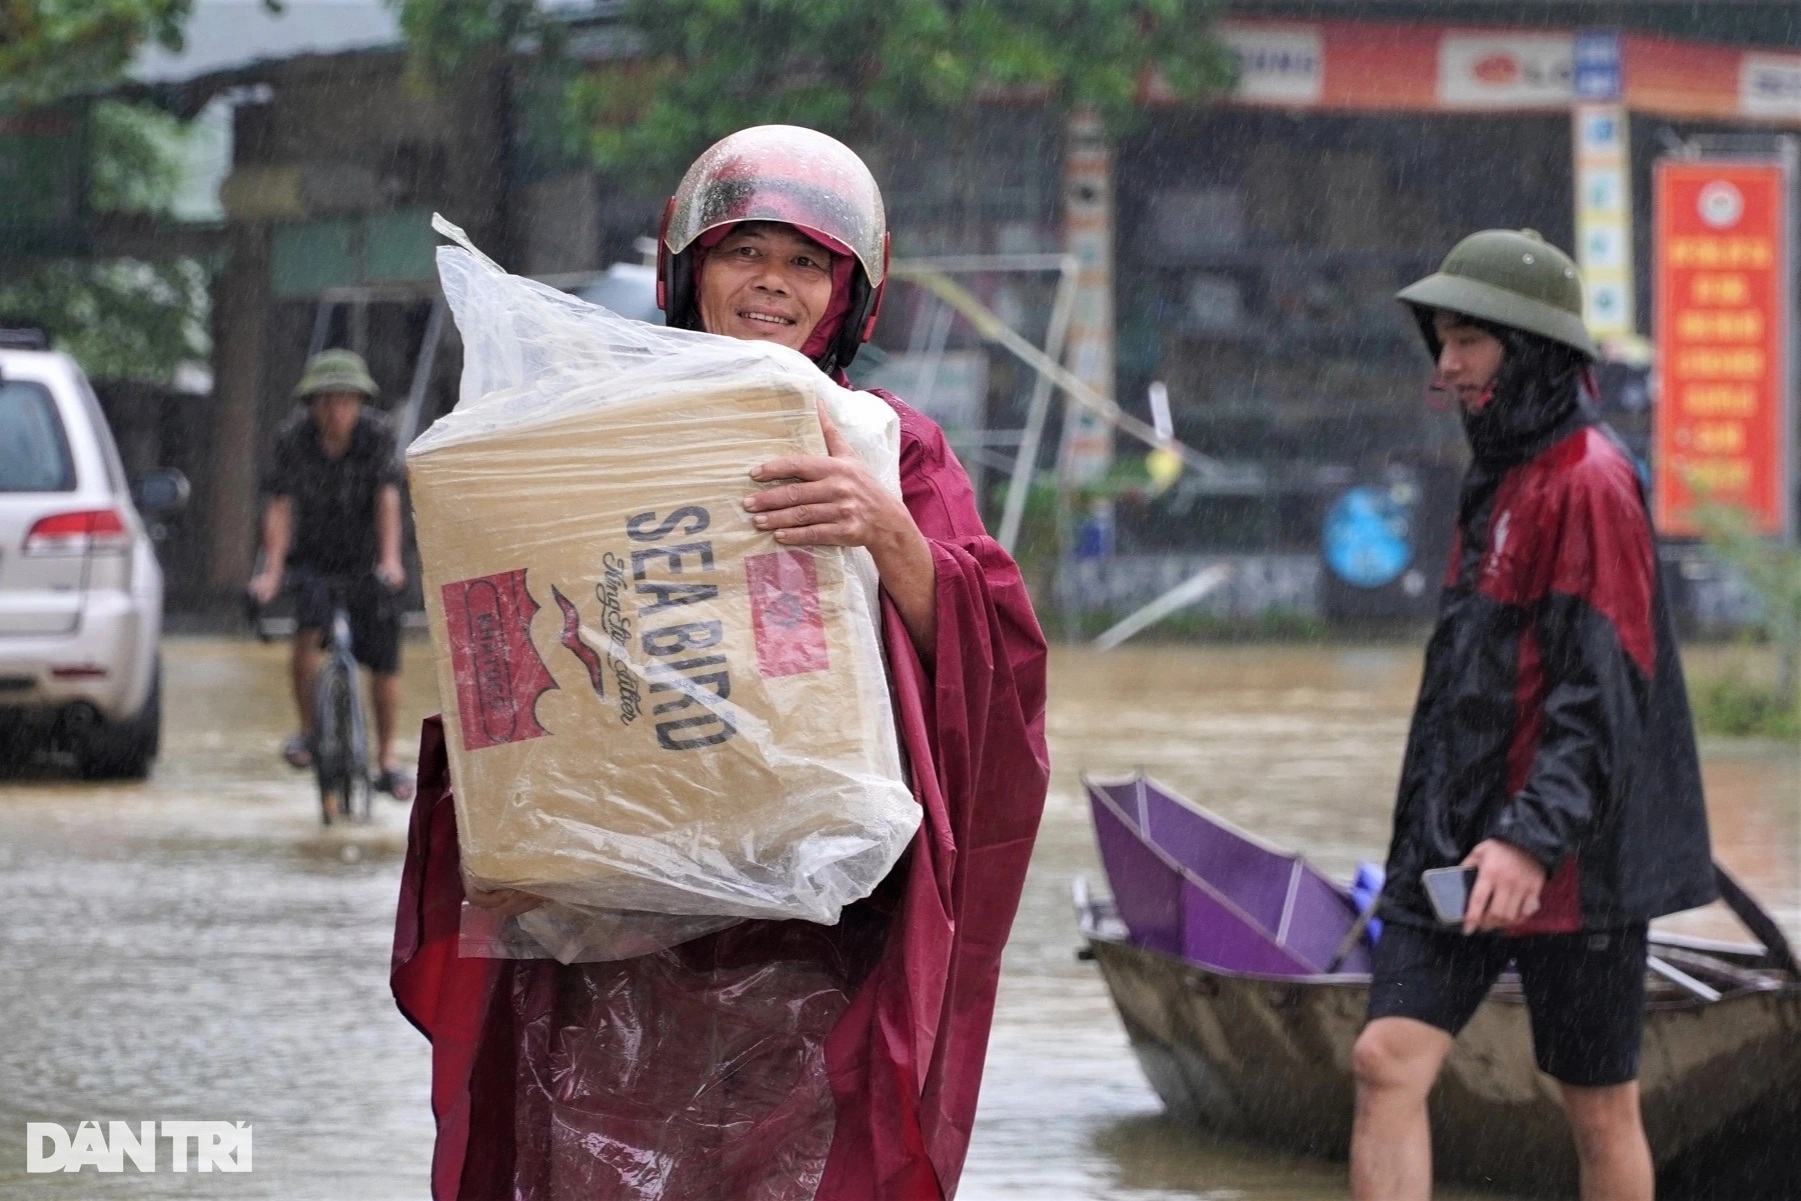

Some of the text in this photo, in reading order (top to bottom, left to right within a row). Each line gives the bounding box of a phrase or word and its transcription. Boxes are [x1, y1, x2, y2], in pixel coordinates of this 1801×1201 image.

[596, 552, 628, 613] King
[614, 659, 643, 726] Filter
[626, 505, 737, 751] SEA BIRD
